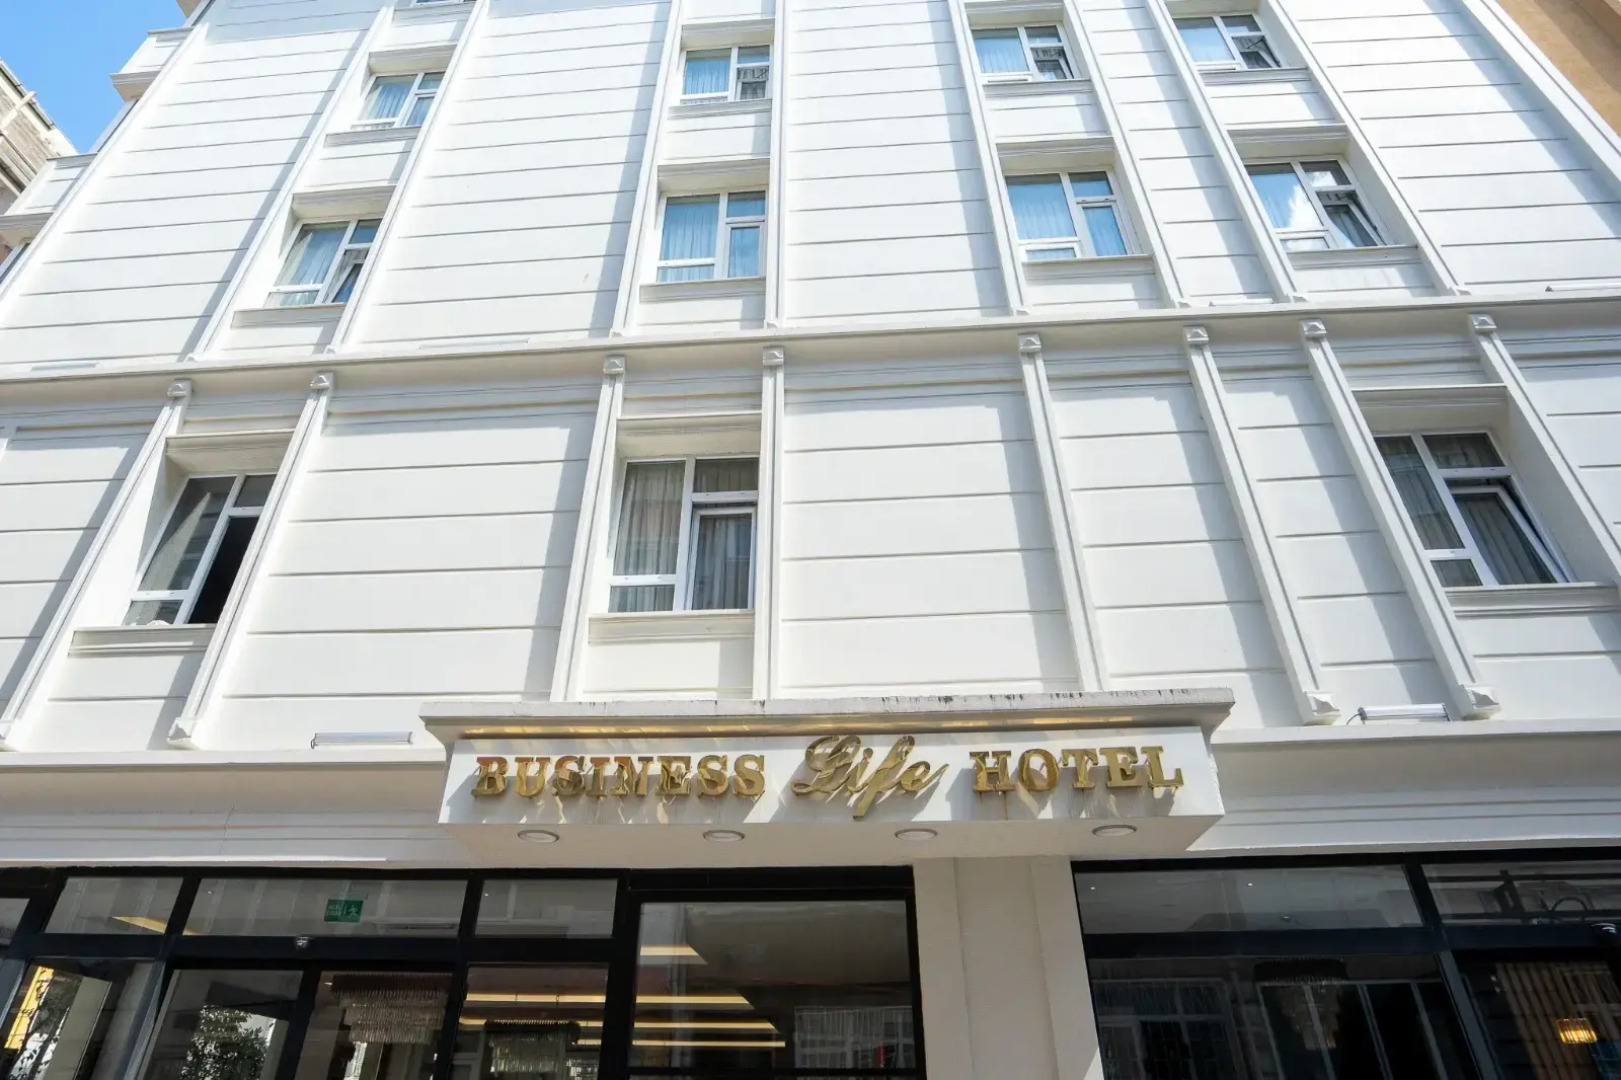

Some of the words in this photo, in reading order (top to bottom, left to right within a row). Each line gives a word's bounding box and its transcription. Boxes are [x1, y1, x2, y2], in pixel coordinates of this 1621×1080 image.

[473, 754, 765, 798] BUSINESS
[791, 735, 948, 820] Life
[970, 745, 1183, 792] HOTEL
